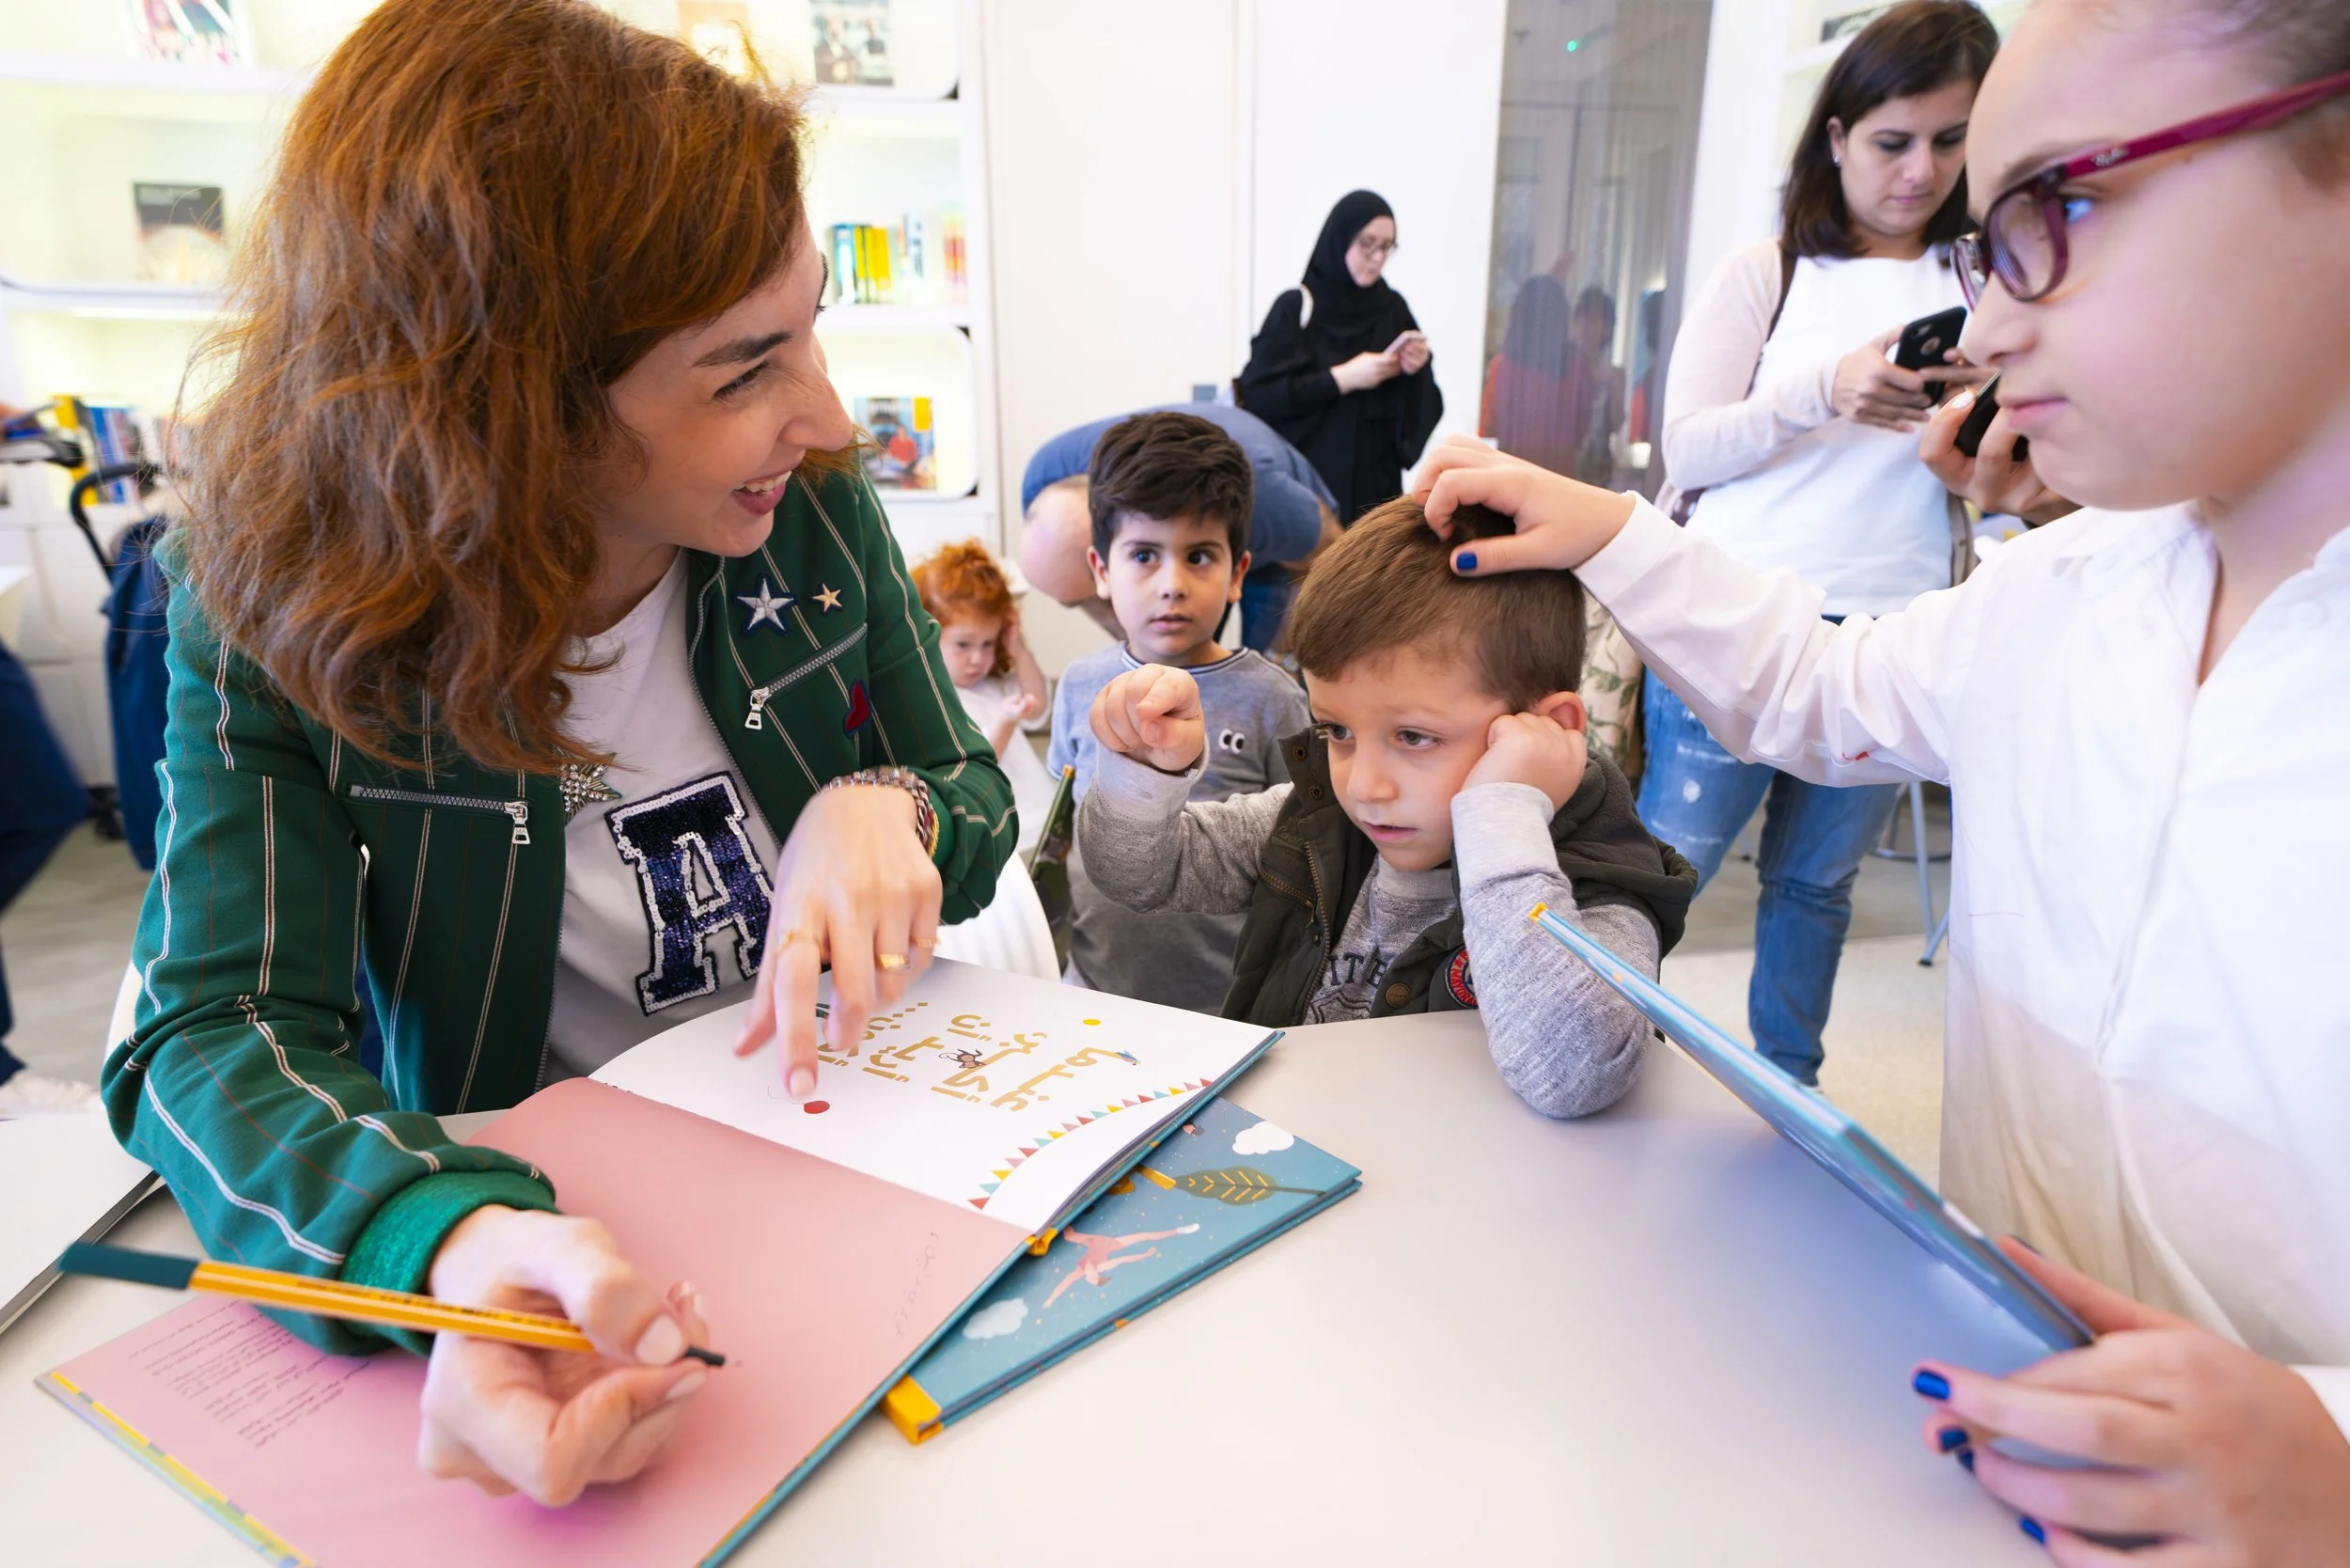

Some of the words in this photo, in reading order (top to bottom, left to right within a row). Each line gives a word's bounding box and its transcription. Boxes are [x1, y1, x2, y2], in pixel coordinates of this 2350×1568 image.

[604, 771, 774, 1017] A
[862, 1036, 945, 1082] أريد
[947, 1014, 992, 1042] أن
[990, 1046, 1122, 1111] عندما
